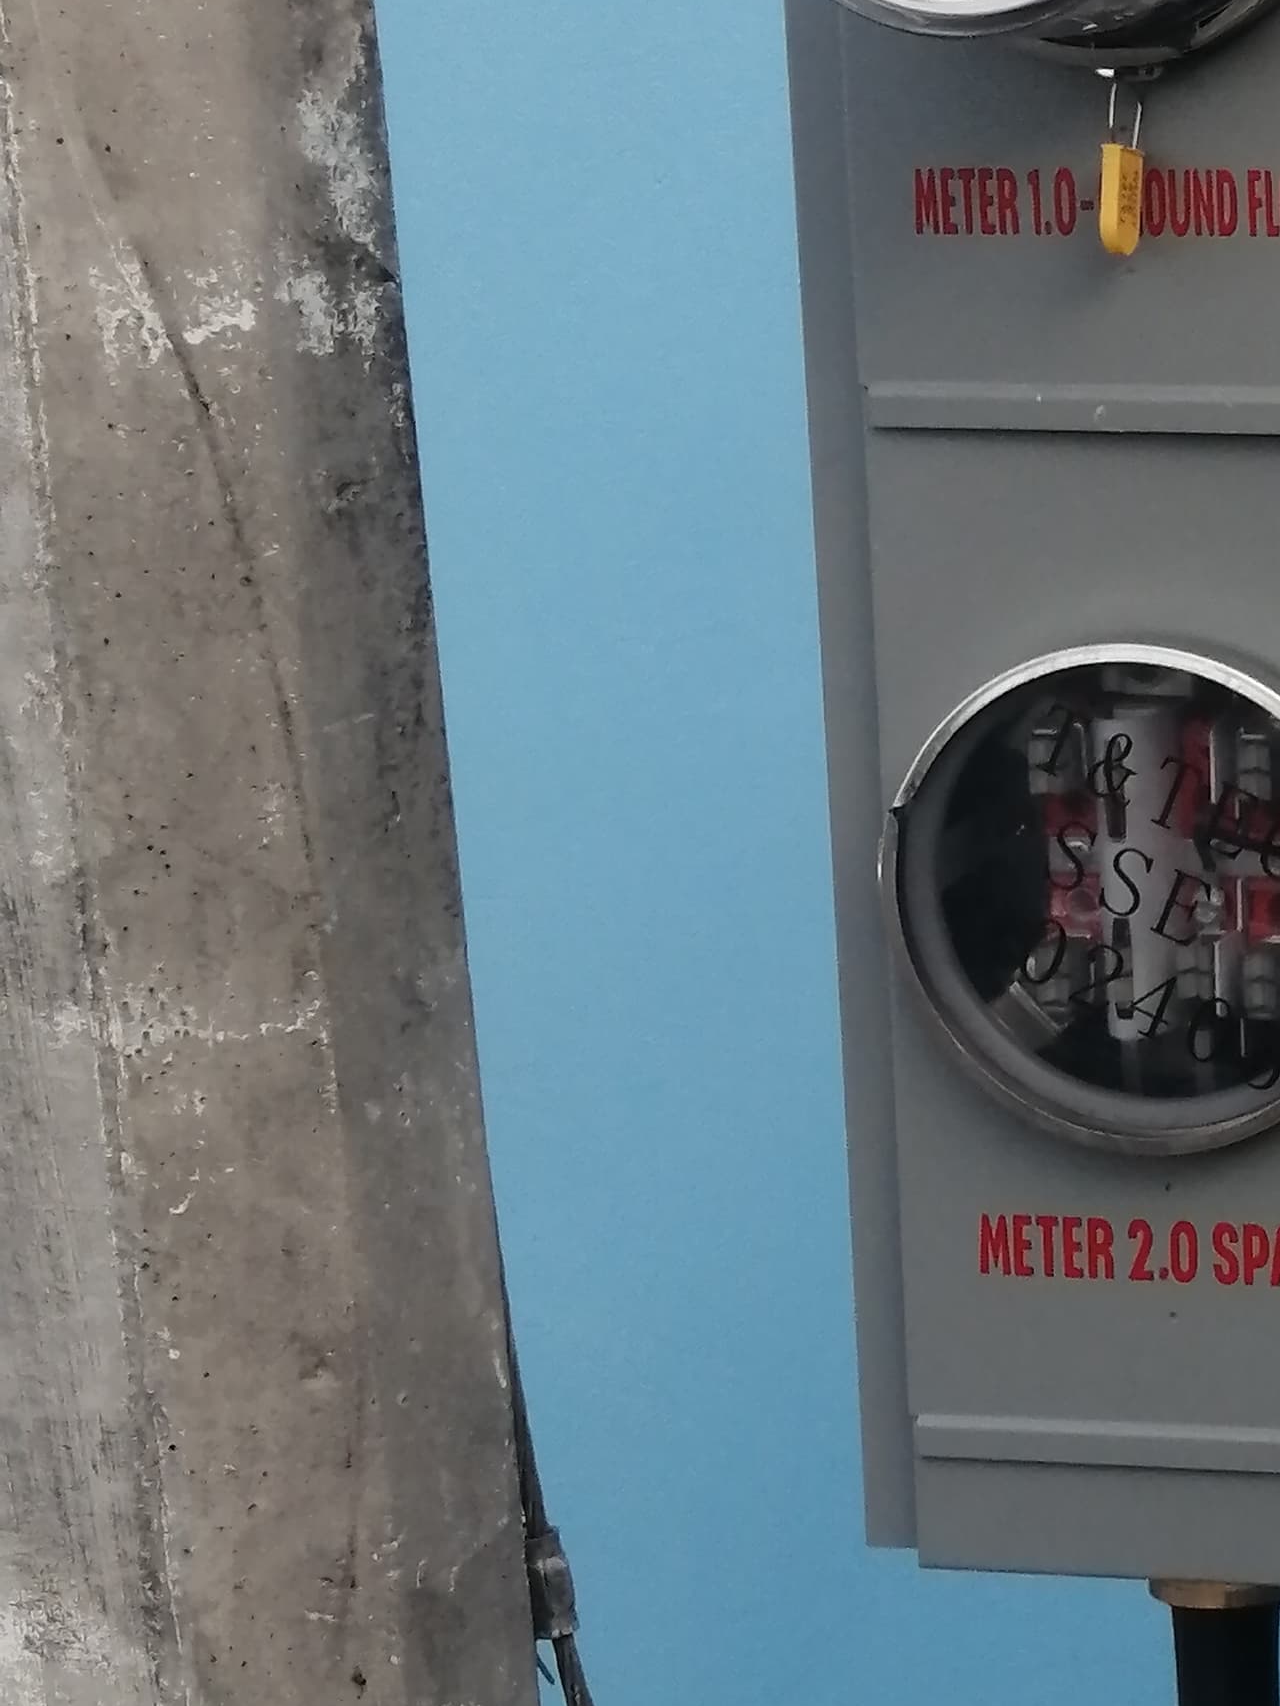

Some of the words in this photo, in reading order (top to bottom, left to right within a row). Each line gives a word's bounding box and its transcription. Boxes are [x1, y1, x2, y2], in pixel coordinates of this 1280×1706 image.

[914, 166, 1021, 236] METER
[1048, 822, 1211, 946] SSE
[979, 1213, 1115, 1281] METER
[1127, 1218, 1199, 1284] 2.0
